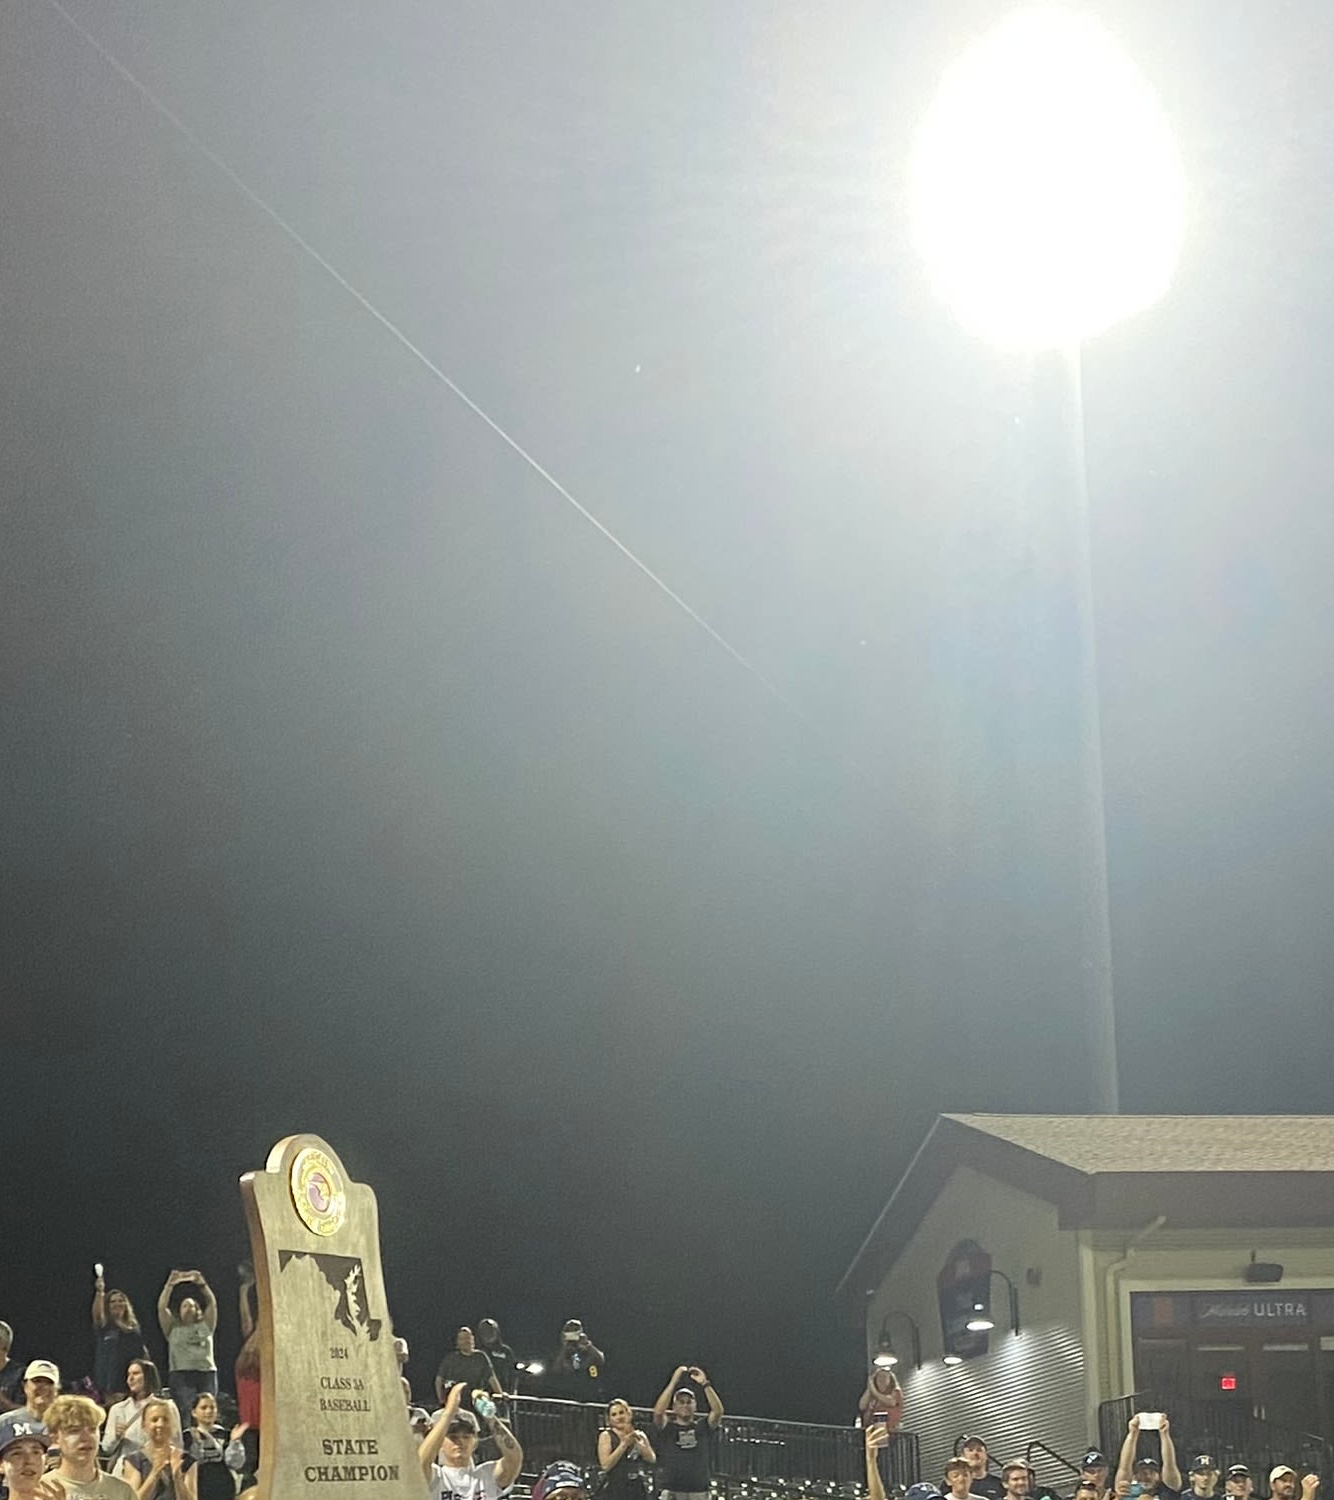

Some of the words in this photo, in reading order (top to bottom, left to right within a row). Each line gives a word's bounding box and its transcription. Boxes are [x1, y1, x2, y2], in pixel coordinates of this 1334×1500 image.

[1254, 1303, 1307, 1317] ULTRA
[330, 1347, 349, 1360] 2024
[320, 1376, 352, 1390] CLASS
[319, 1398, 372, 1412] BASEBALL
[12, 1422, 34, 1436] M
[321, 1439, 379, 1455] STATE
[303, 1466, 401, 1482] CHAMPION
